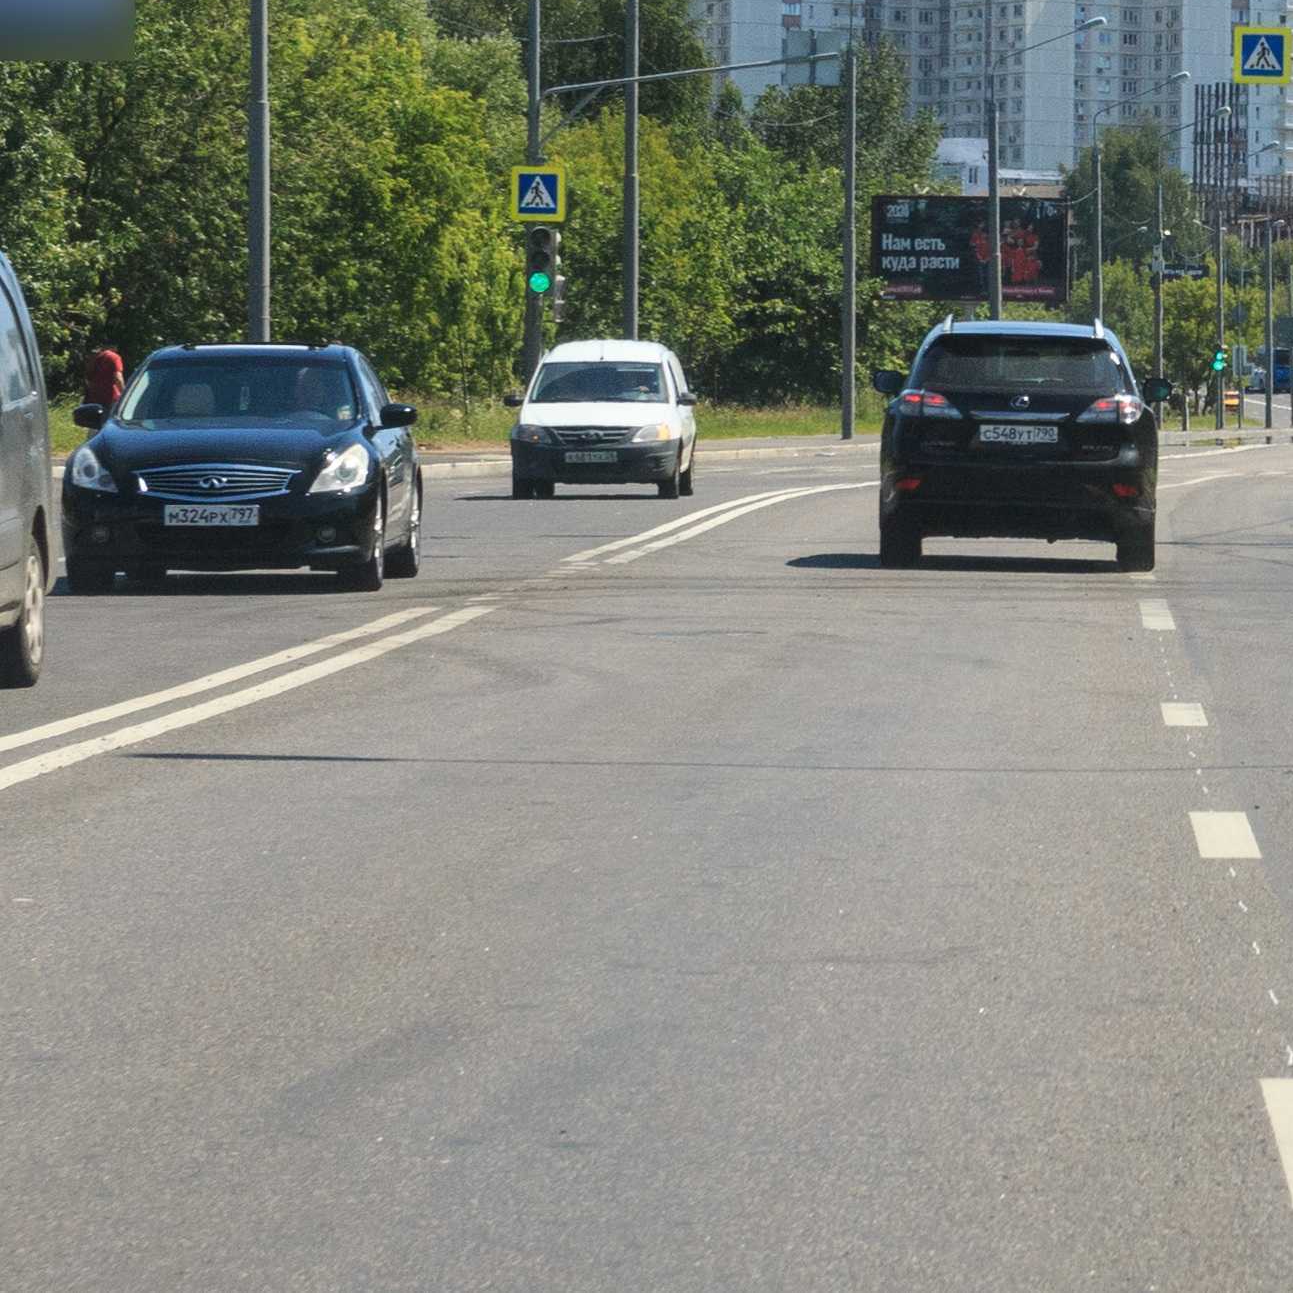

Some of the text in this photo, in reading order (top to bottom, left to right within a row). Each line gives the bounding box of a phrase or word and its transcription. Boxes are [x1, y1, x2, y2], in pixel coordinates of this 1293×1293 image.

[881, 233, 946, 251] Нам есть
[881, 256, 960, 272] куда расти
[982, 427, 1054, 440] С548УТ 790
[168, 507, 253, 524] М324РХ 797
